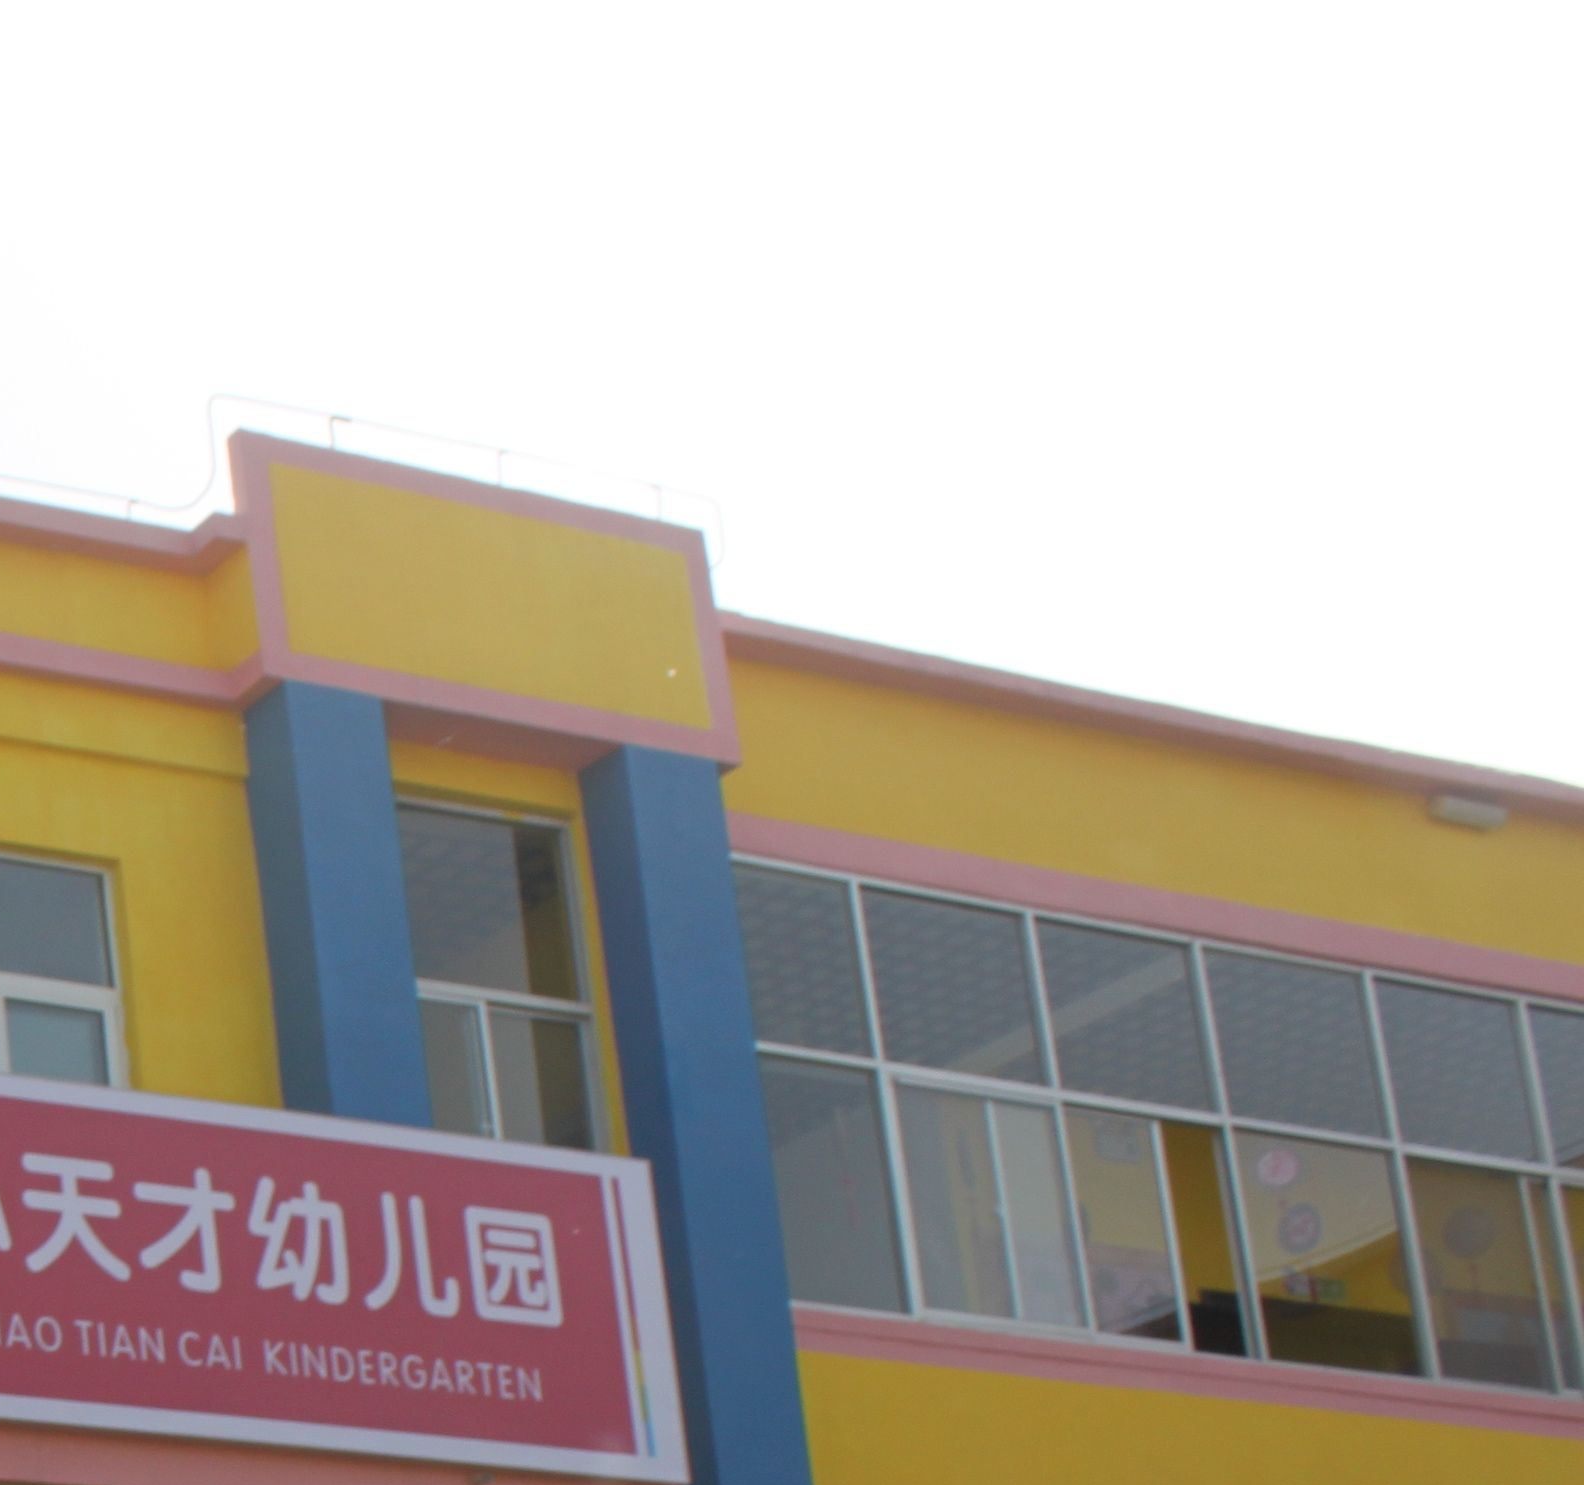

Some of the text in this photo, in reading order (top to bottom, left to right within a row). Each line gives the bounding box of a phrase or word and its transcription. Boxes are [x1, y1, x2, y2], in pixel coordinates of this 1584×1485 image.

[74, 1320, 166, 1363] TIAN
[178, 1332, 242, 1370] CAI
[263, 1340, 544, 1402] KINDERGARTEN
